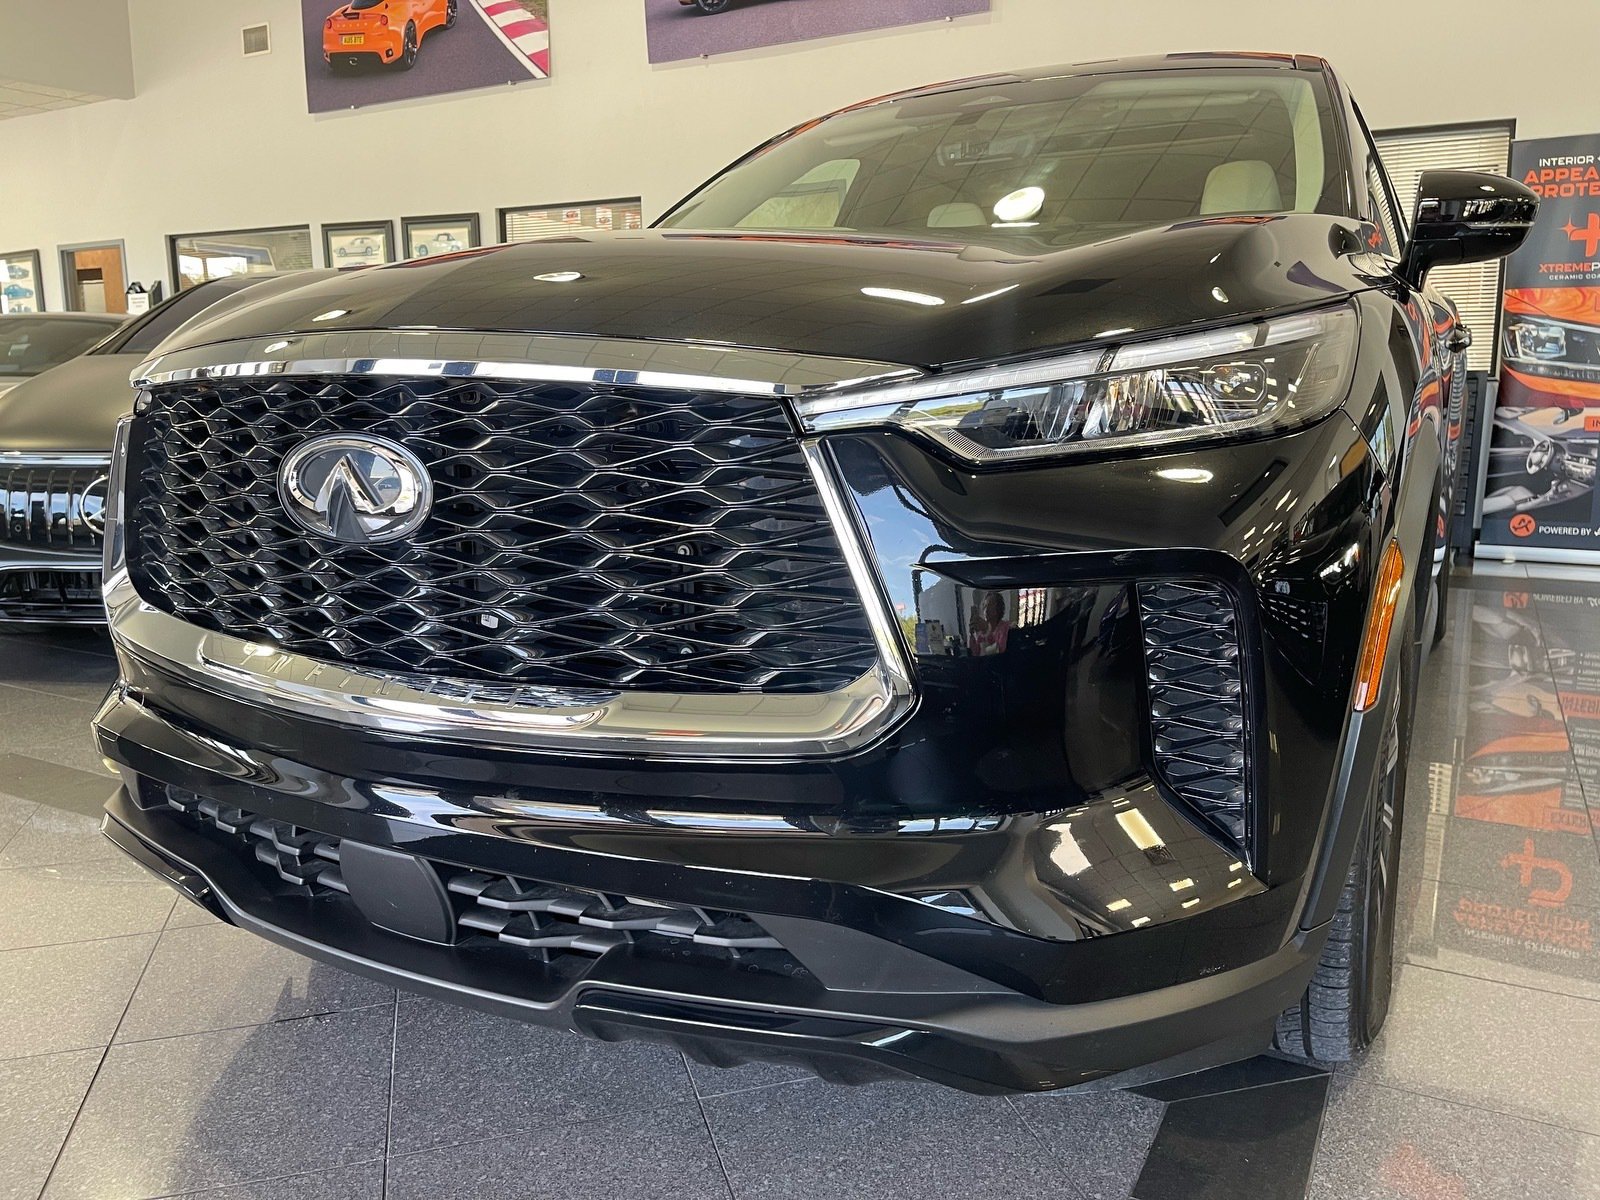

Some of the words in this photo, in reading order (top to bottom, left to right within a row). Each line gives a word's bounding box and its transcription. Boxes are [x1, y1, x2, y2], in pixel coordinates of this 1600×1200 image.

[1539, 155, 1594, 167] INTERIOR
[1523, 166, 1600, 184] APPEA
[1538, 525, 1579, 535] POWERED
[1580, 527, 1592, 536] BY
